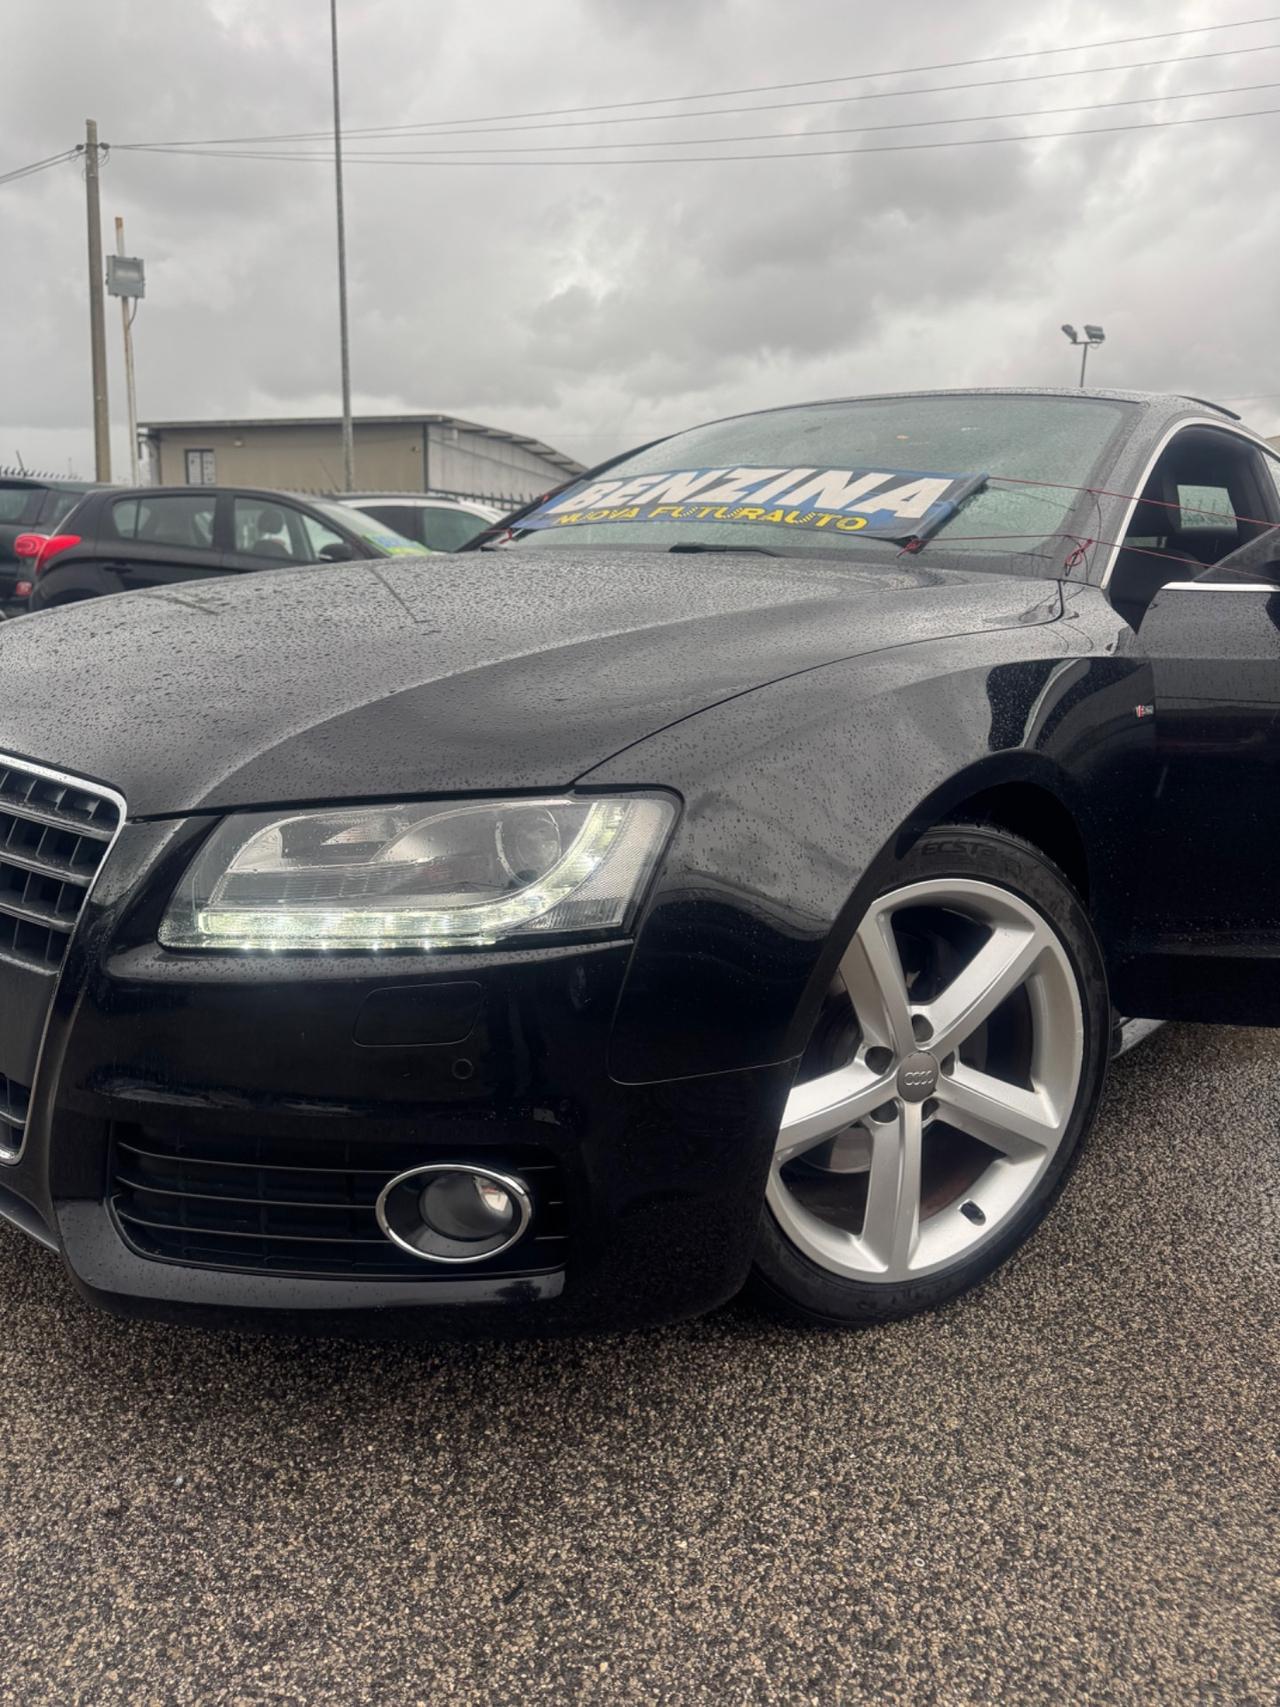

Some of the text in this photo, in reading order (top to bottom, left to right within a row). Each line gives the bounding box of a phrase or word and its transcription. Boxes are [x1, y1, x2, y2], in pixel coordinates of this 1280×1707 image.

[545, 468, 954, 519] BENZINA
[555, 505, 869, 531] NUOVA FUTURAUTO
